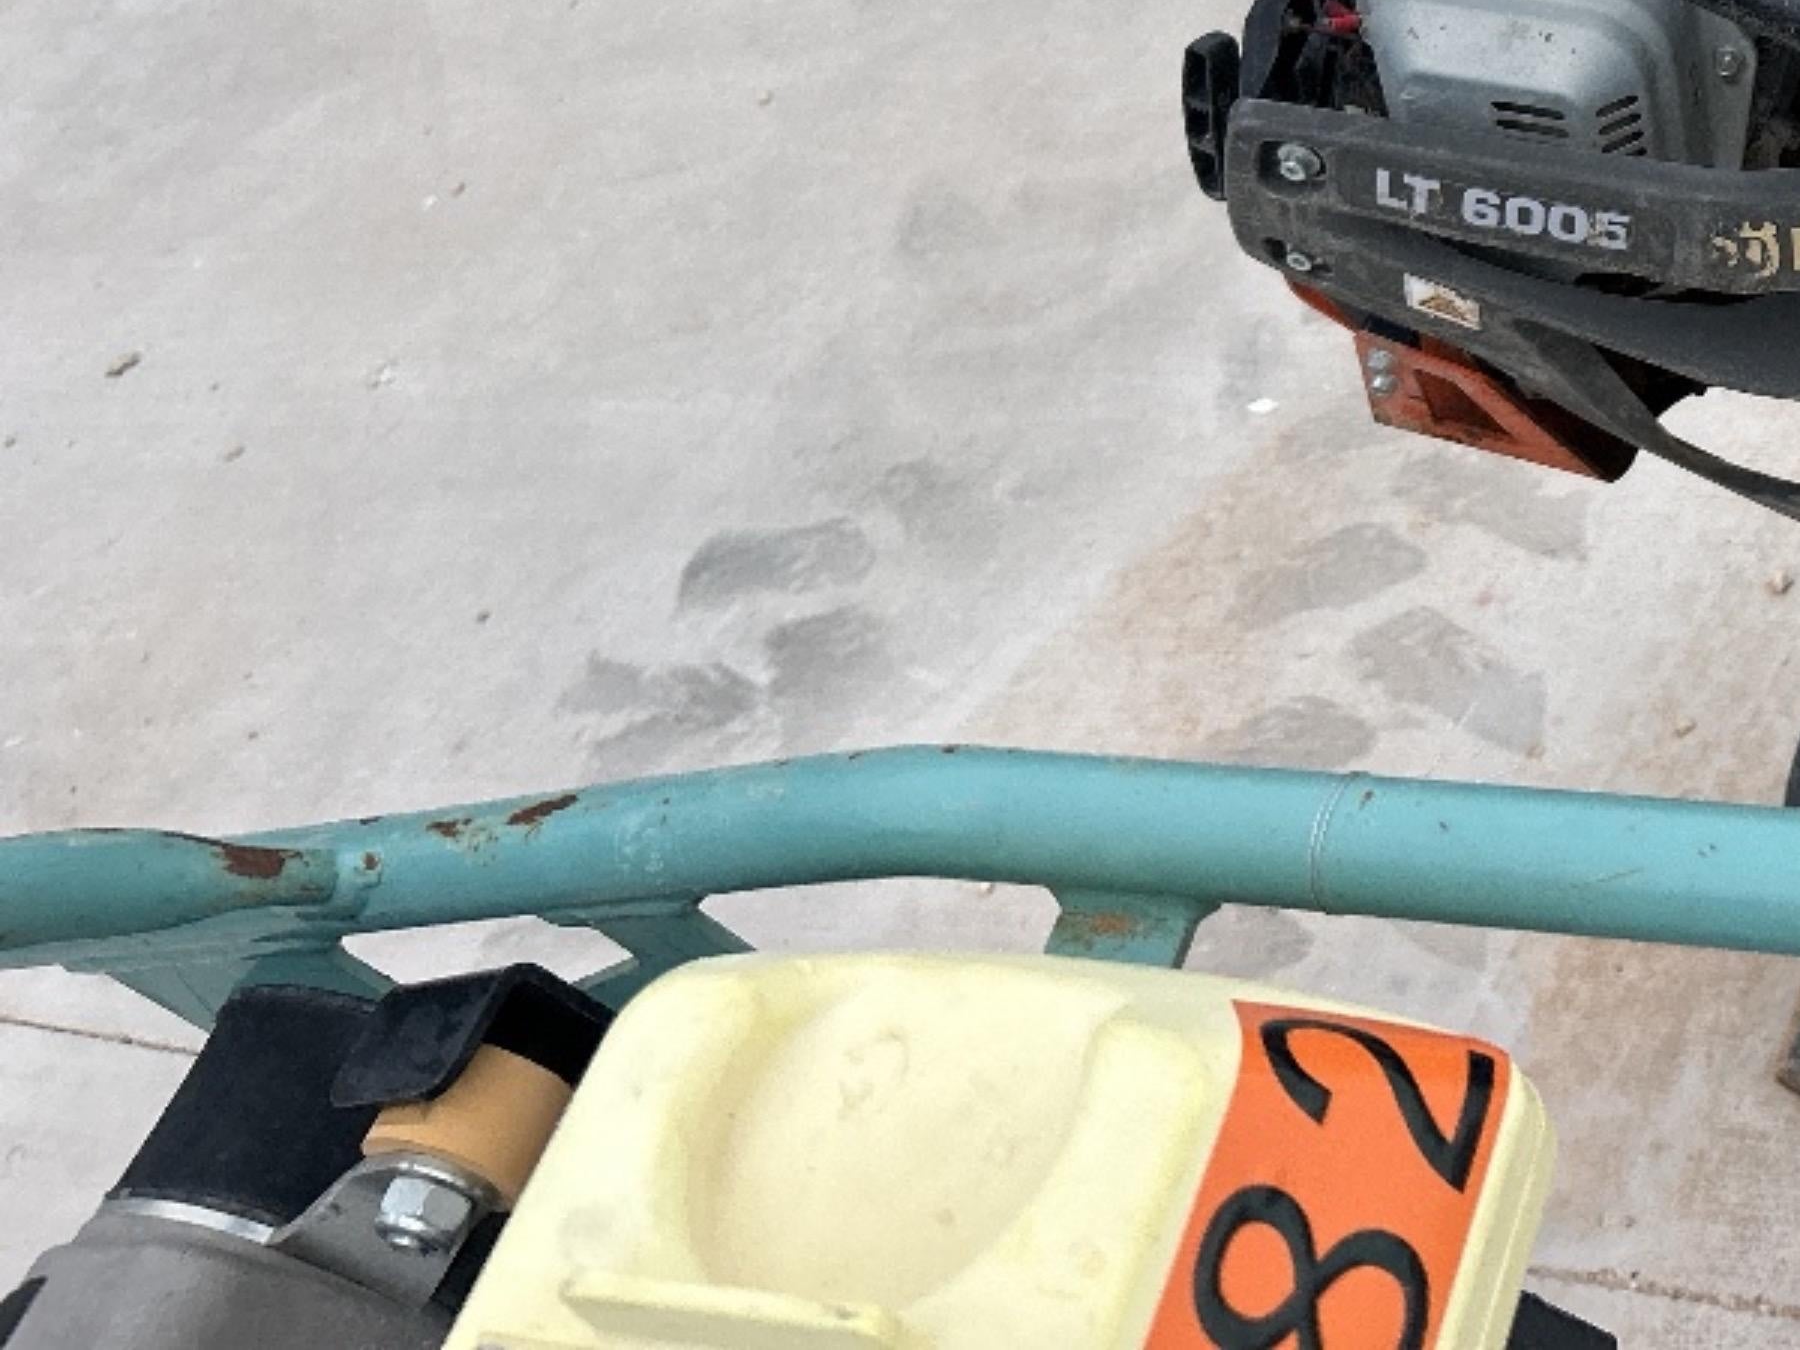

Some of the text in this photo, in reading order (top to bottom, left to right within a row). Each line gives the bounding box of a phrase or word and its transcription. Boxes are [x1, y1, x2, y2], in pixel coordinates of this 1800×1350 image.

[1376, 167, 1632, 251] LT 6005
[1193, 1017, 1495, 1350] 82
